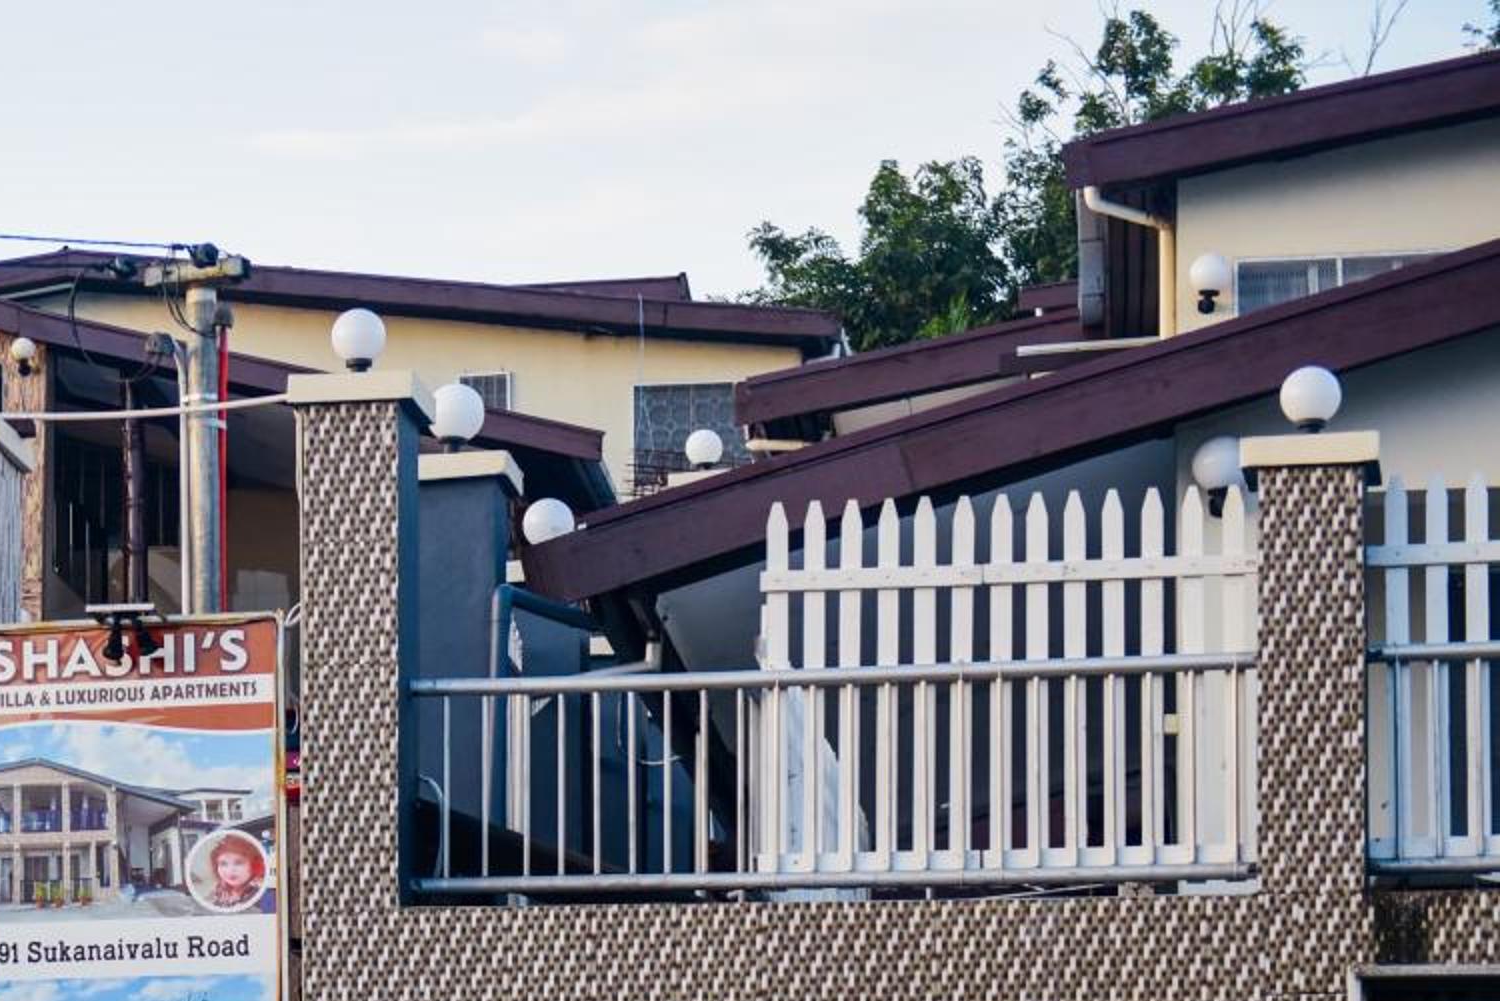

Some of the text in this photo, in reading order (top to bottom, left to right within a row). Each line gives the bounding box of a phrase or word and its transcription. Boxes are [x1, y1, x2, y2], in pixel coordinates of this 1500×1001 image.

[39, 690, 51, 707] &
[56, 686, 146, 706] LUXURIOUS
[150, 681, 258, 702] APARTMENTS
[27, 938, 179, 963] Sukanaivalu
[187, 935, 250, 959] Road
